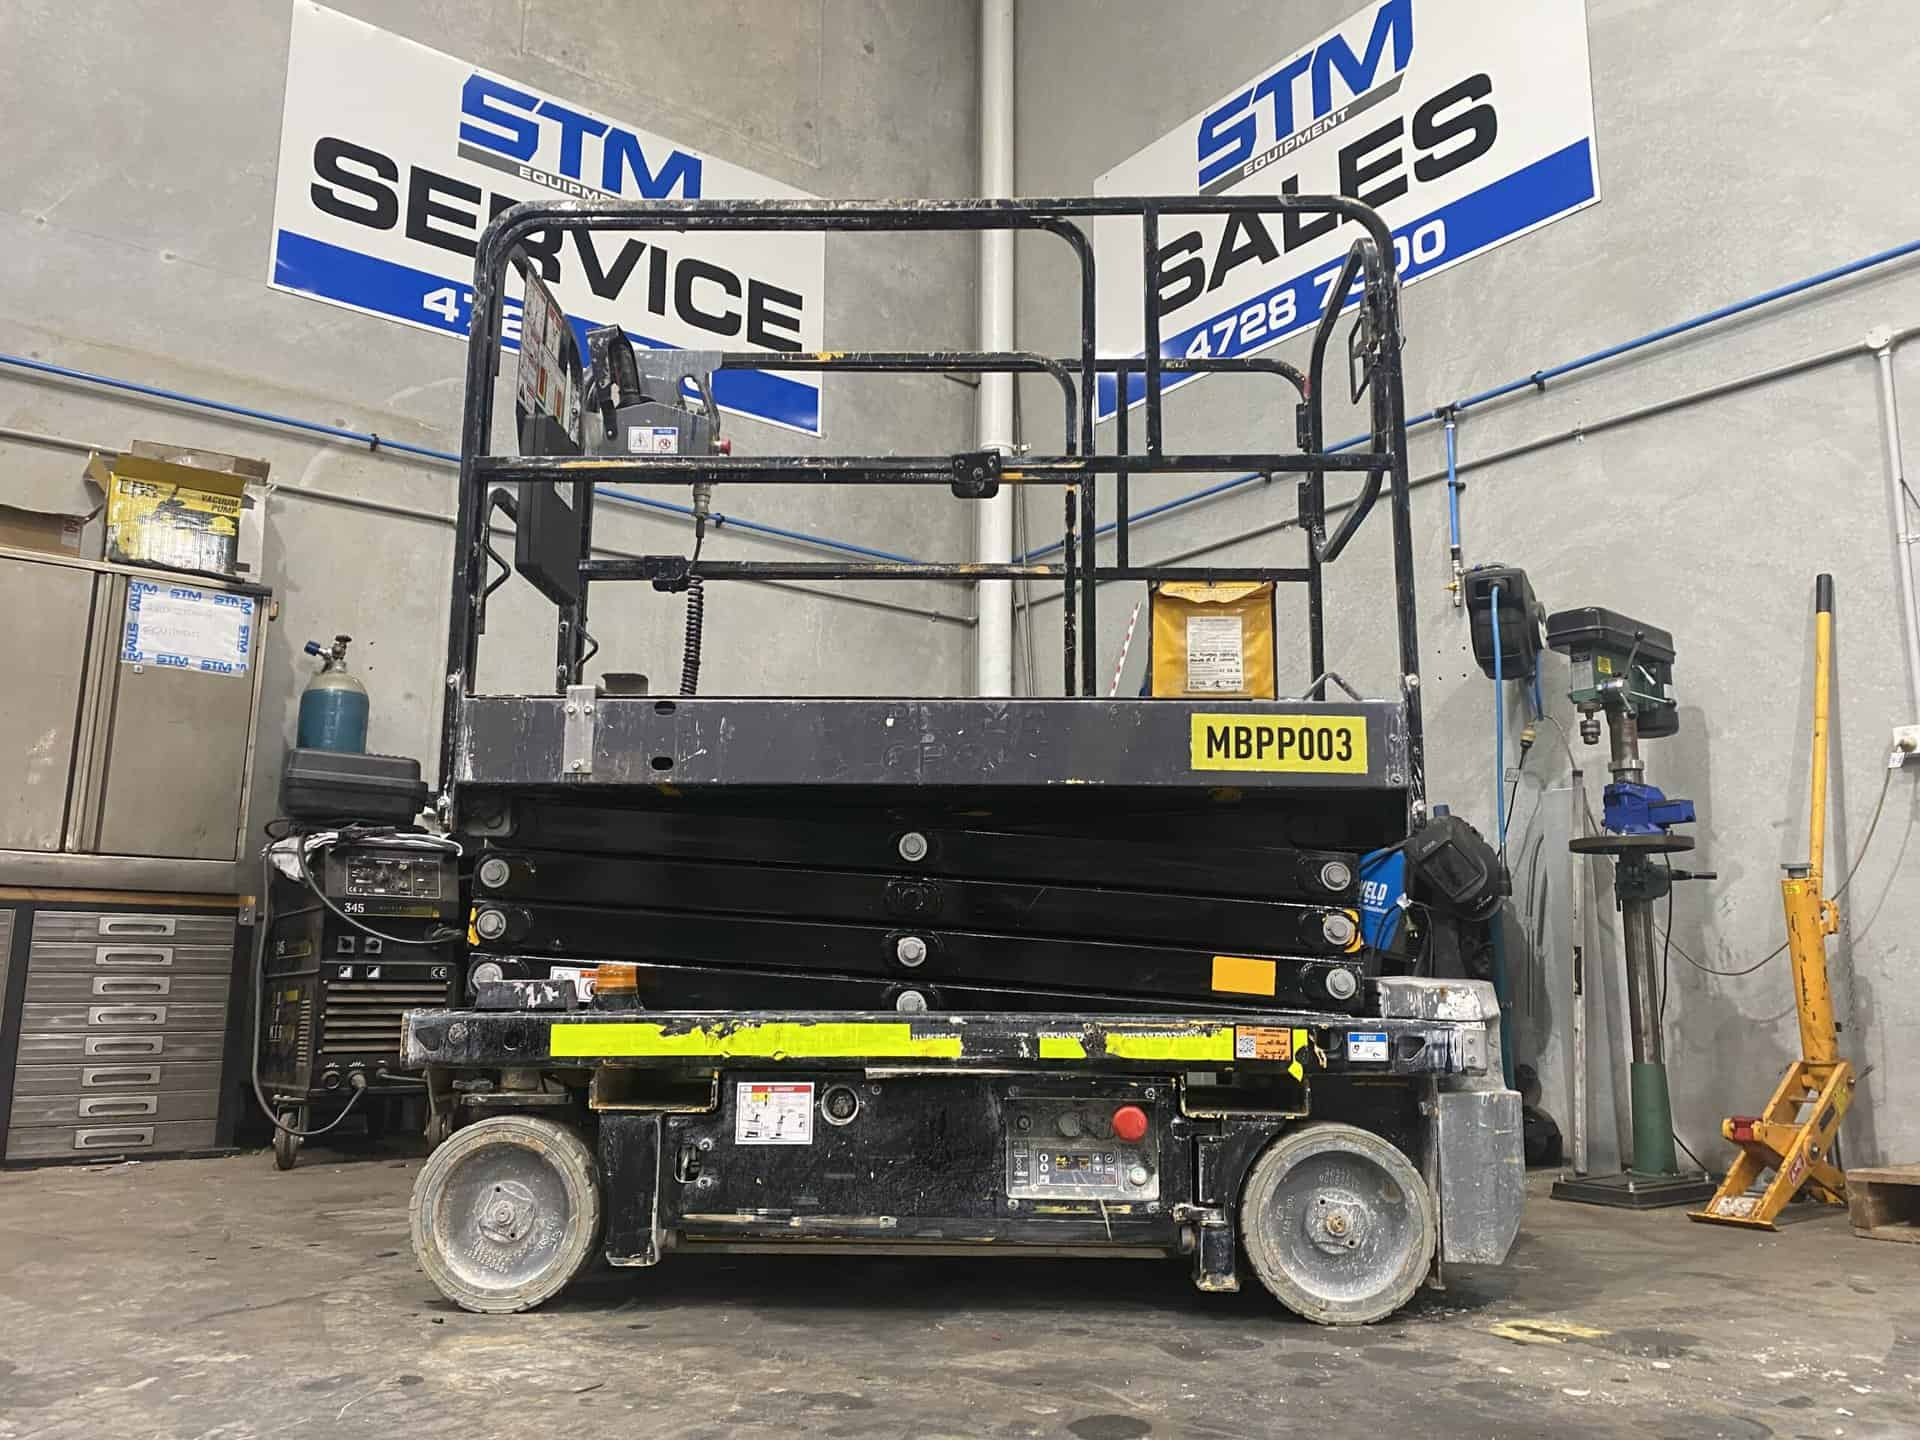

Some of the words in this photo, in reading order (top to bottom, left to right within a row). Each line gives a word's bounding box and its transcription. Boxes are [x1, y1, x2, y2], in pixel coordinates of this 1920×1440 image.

[1197, 0, 1414, 187] STM
[459, 73, 702, 200] STM
[1243, 107, 1349, 177] EQUIPMENT
[1158, 73, 1498, 318] SALES
[1186, 288, 1297, 360] 4728
[169, 588, 202, 601] STM
[126, 623, 140, 652] STM
[239, 624, 249, 653] STM
[156, 654, 189, 667] STM
[200, 660, 233, 673] STM
[1206, 724, 1353, 762] MBPP003
[344, 902, 365, 913] 345
